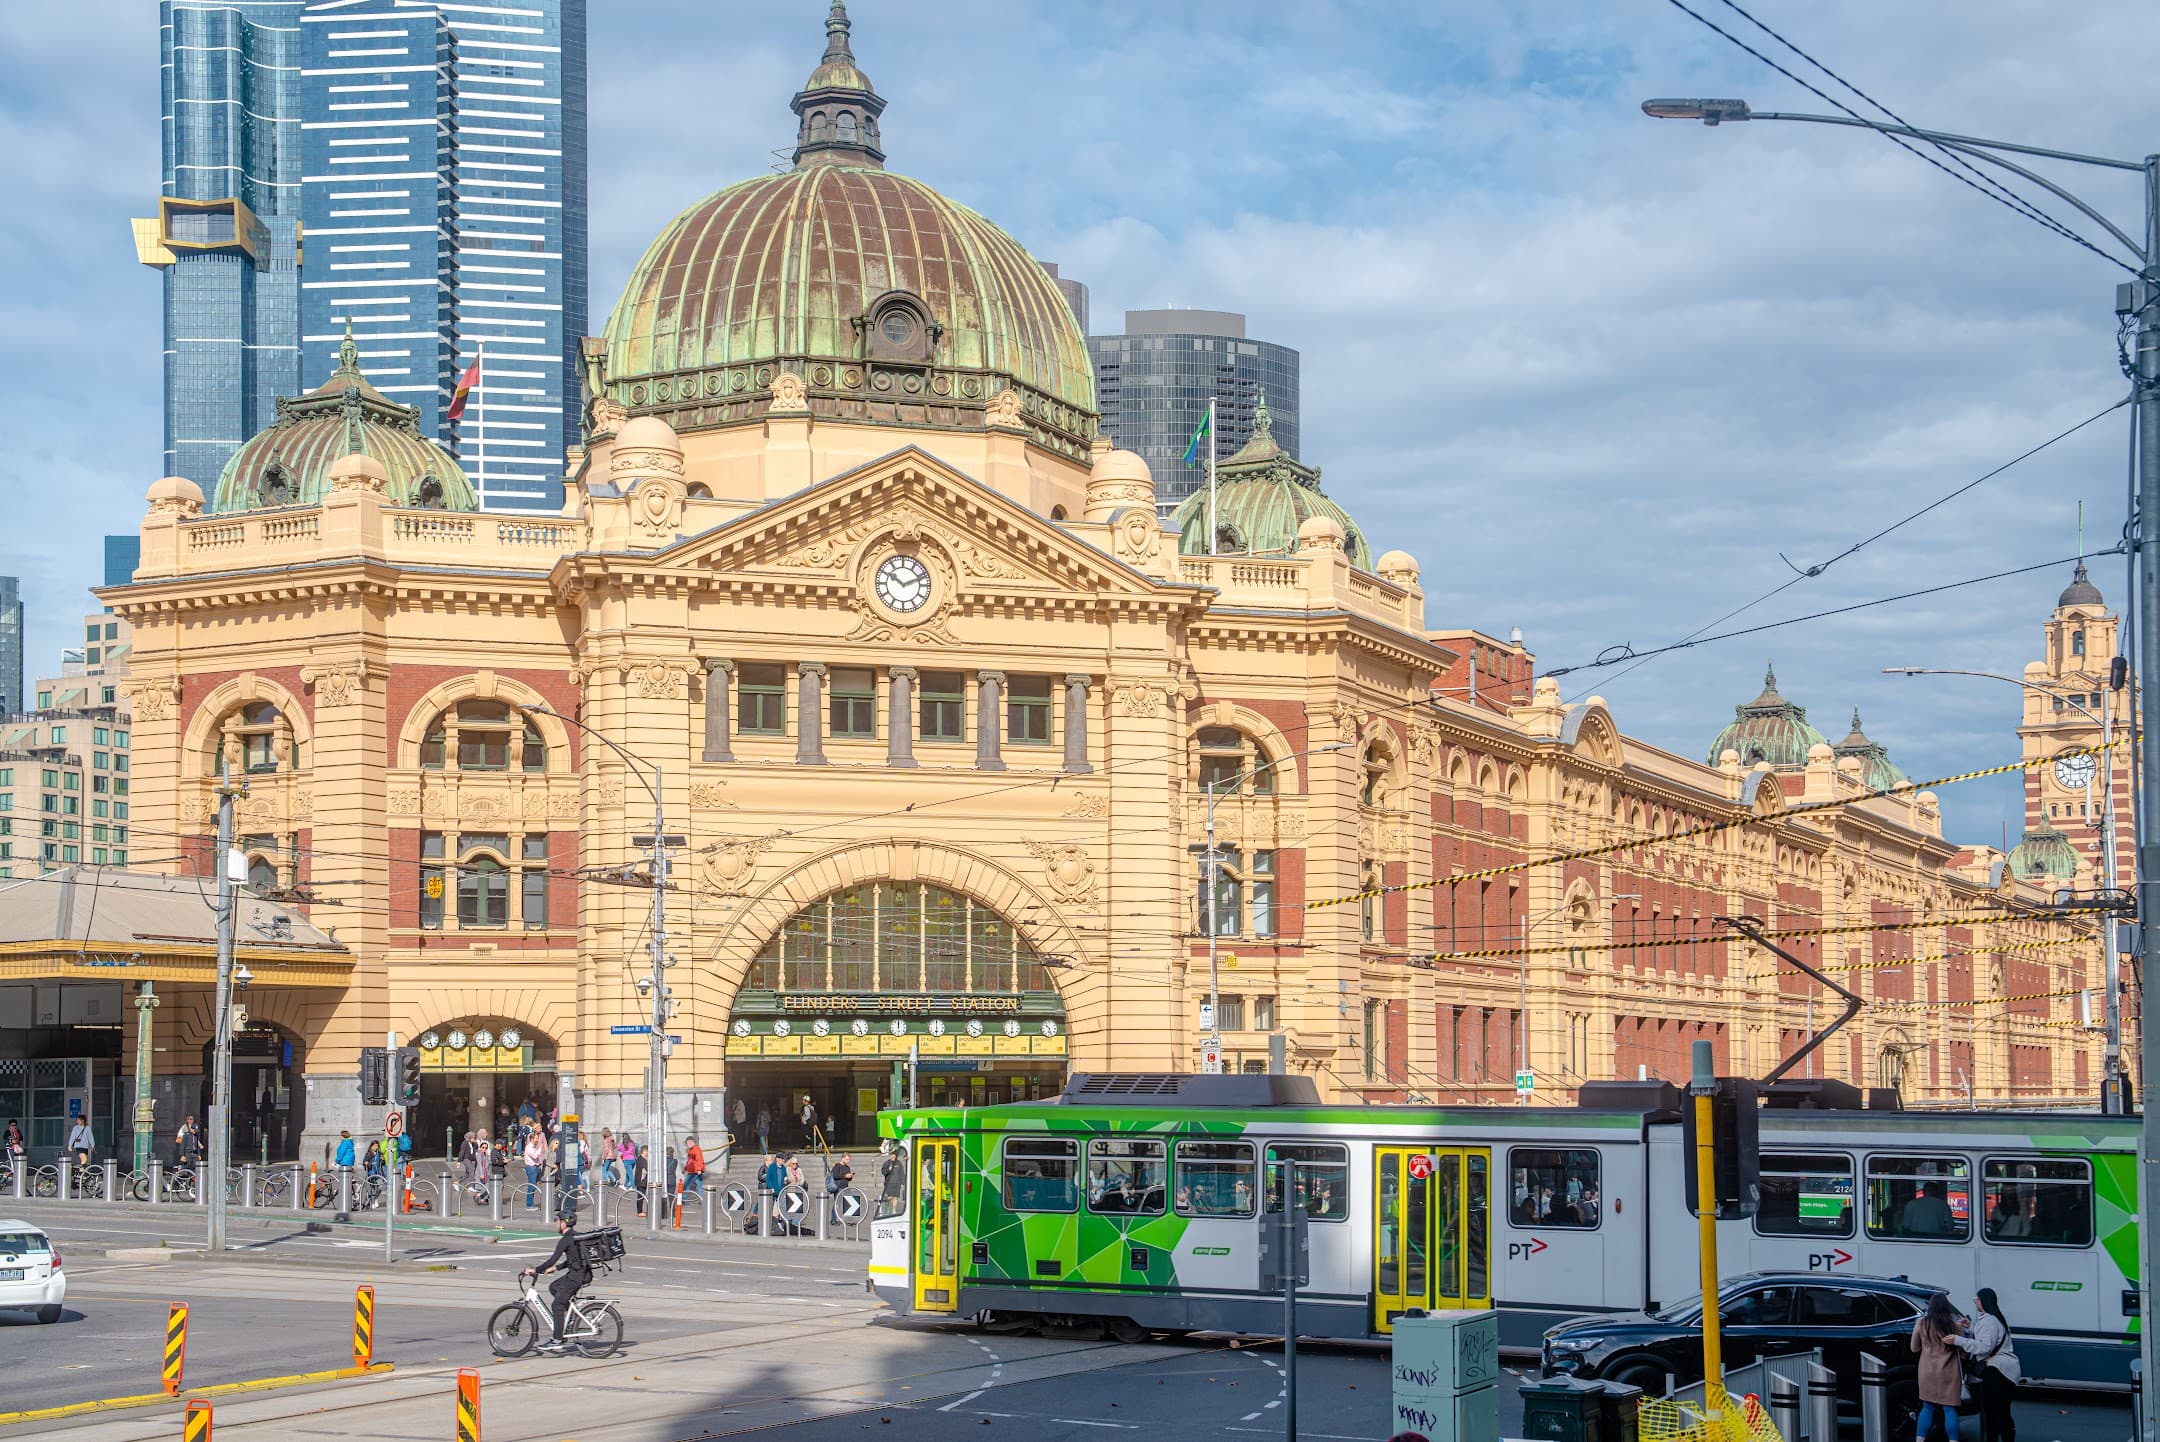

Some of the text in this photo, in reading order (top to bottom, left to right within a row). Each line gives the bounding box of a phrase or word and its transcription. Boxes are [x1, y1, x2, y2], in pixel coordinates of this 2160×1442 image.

[784, 996, 1018, 1010] FLINDERS STREET STATION
[876, 1228, 894, 1240] 2094
